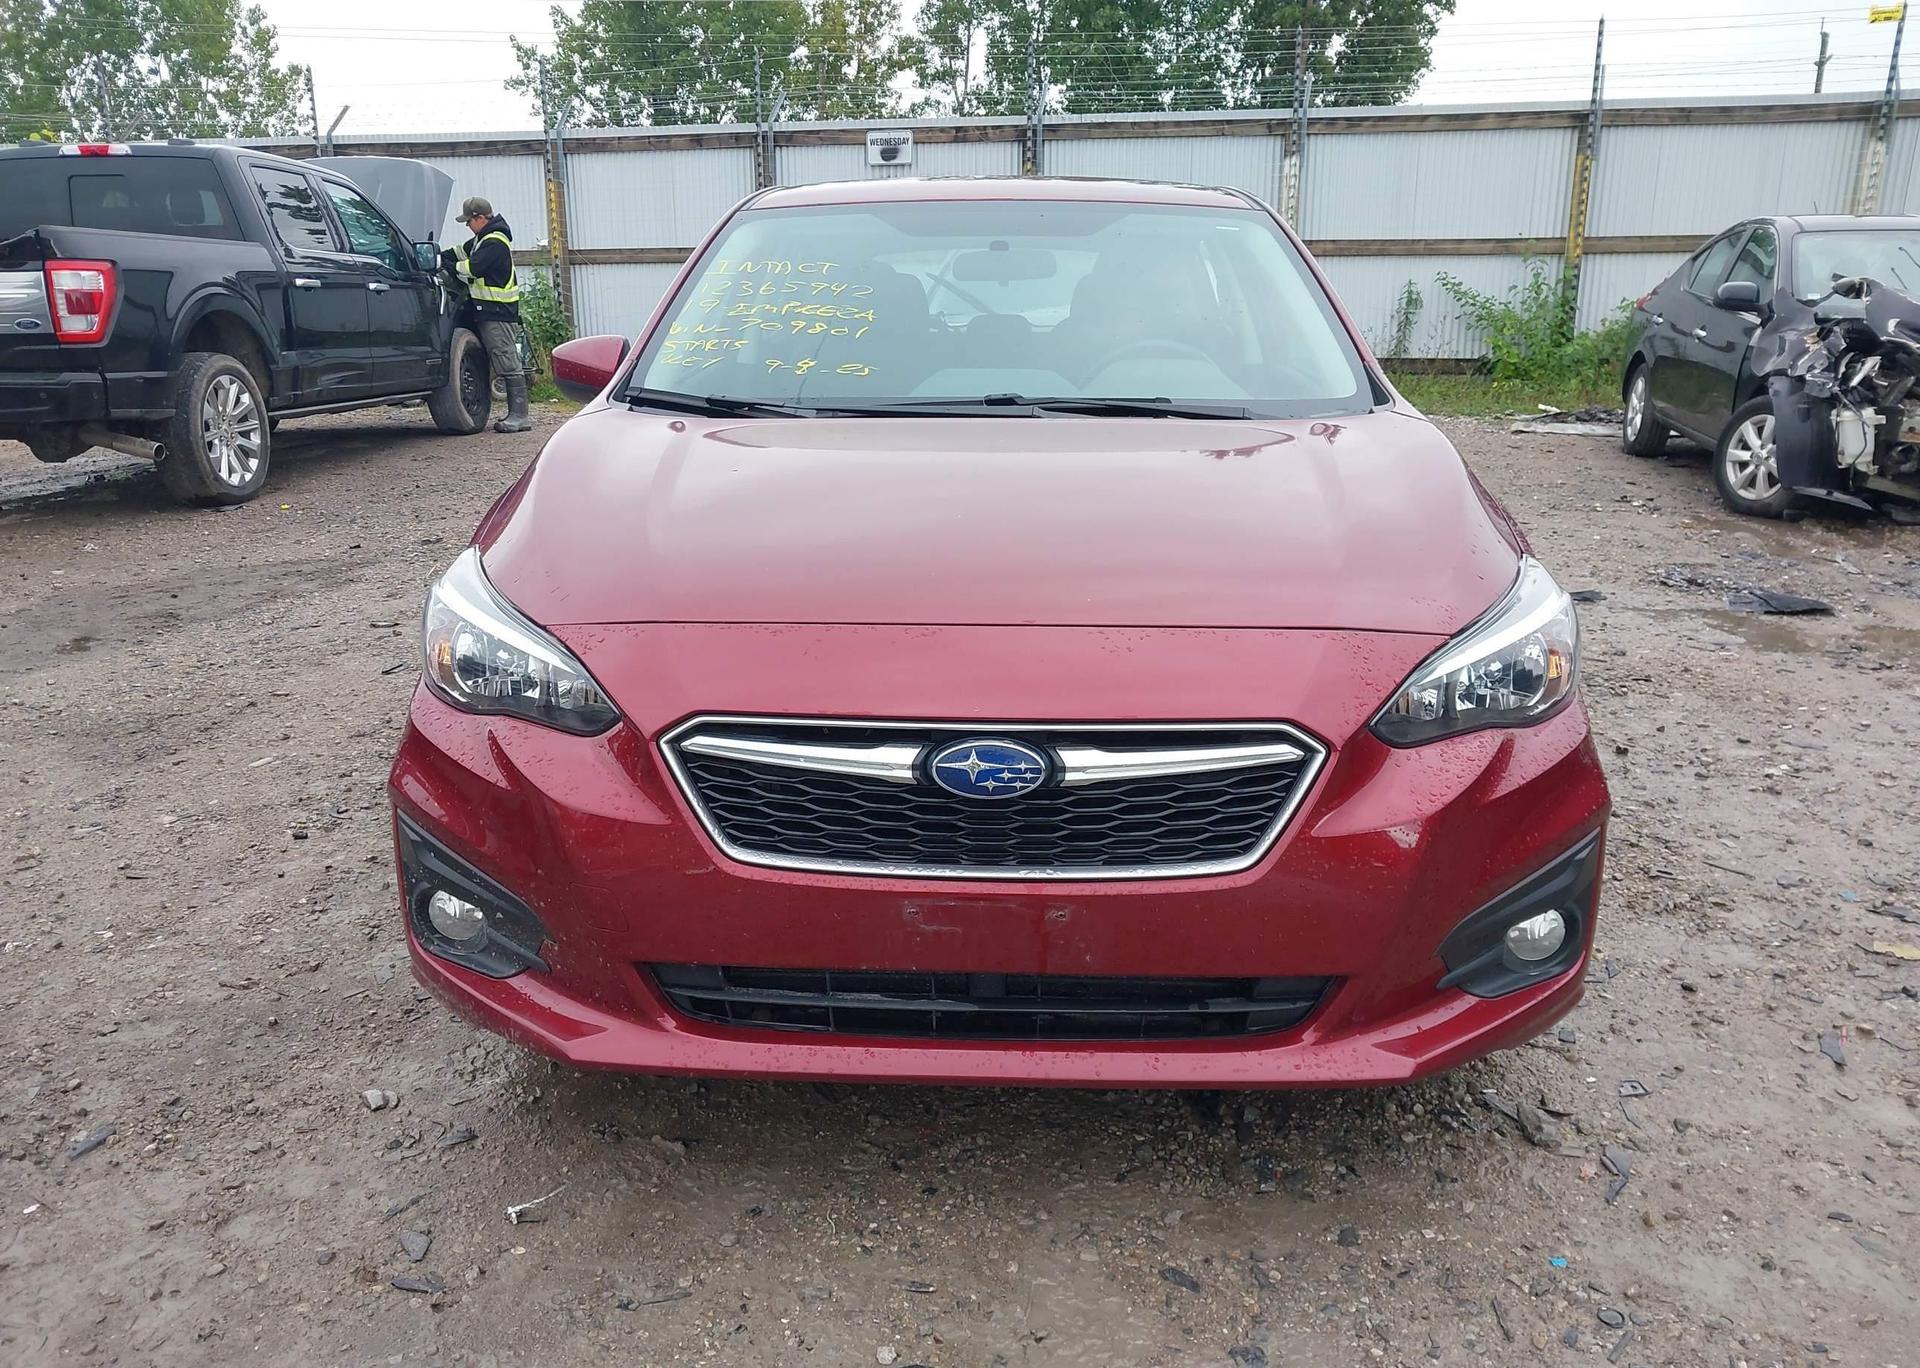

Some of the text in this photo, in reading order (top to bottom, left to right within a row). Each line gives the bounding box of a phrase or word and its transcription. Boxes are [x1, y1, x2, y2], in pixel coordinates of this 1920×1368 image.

[869, 137, 910, 146] WEDNESDAY
[704, 259, 840, 276] INTACT
[662, 339, 751, 353] STARTS
